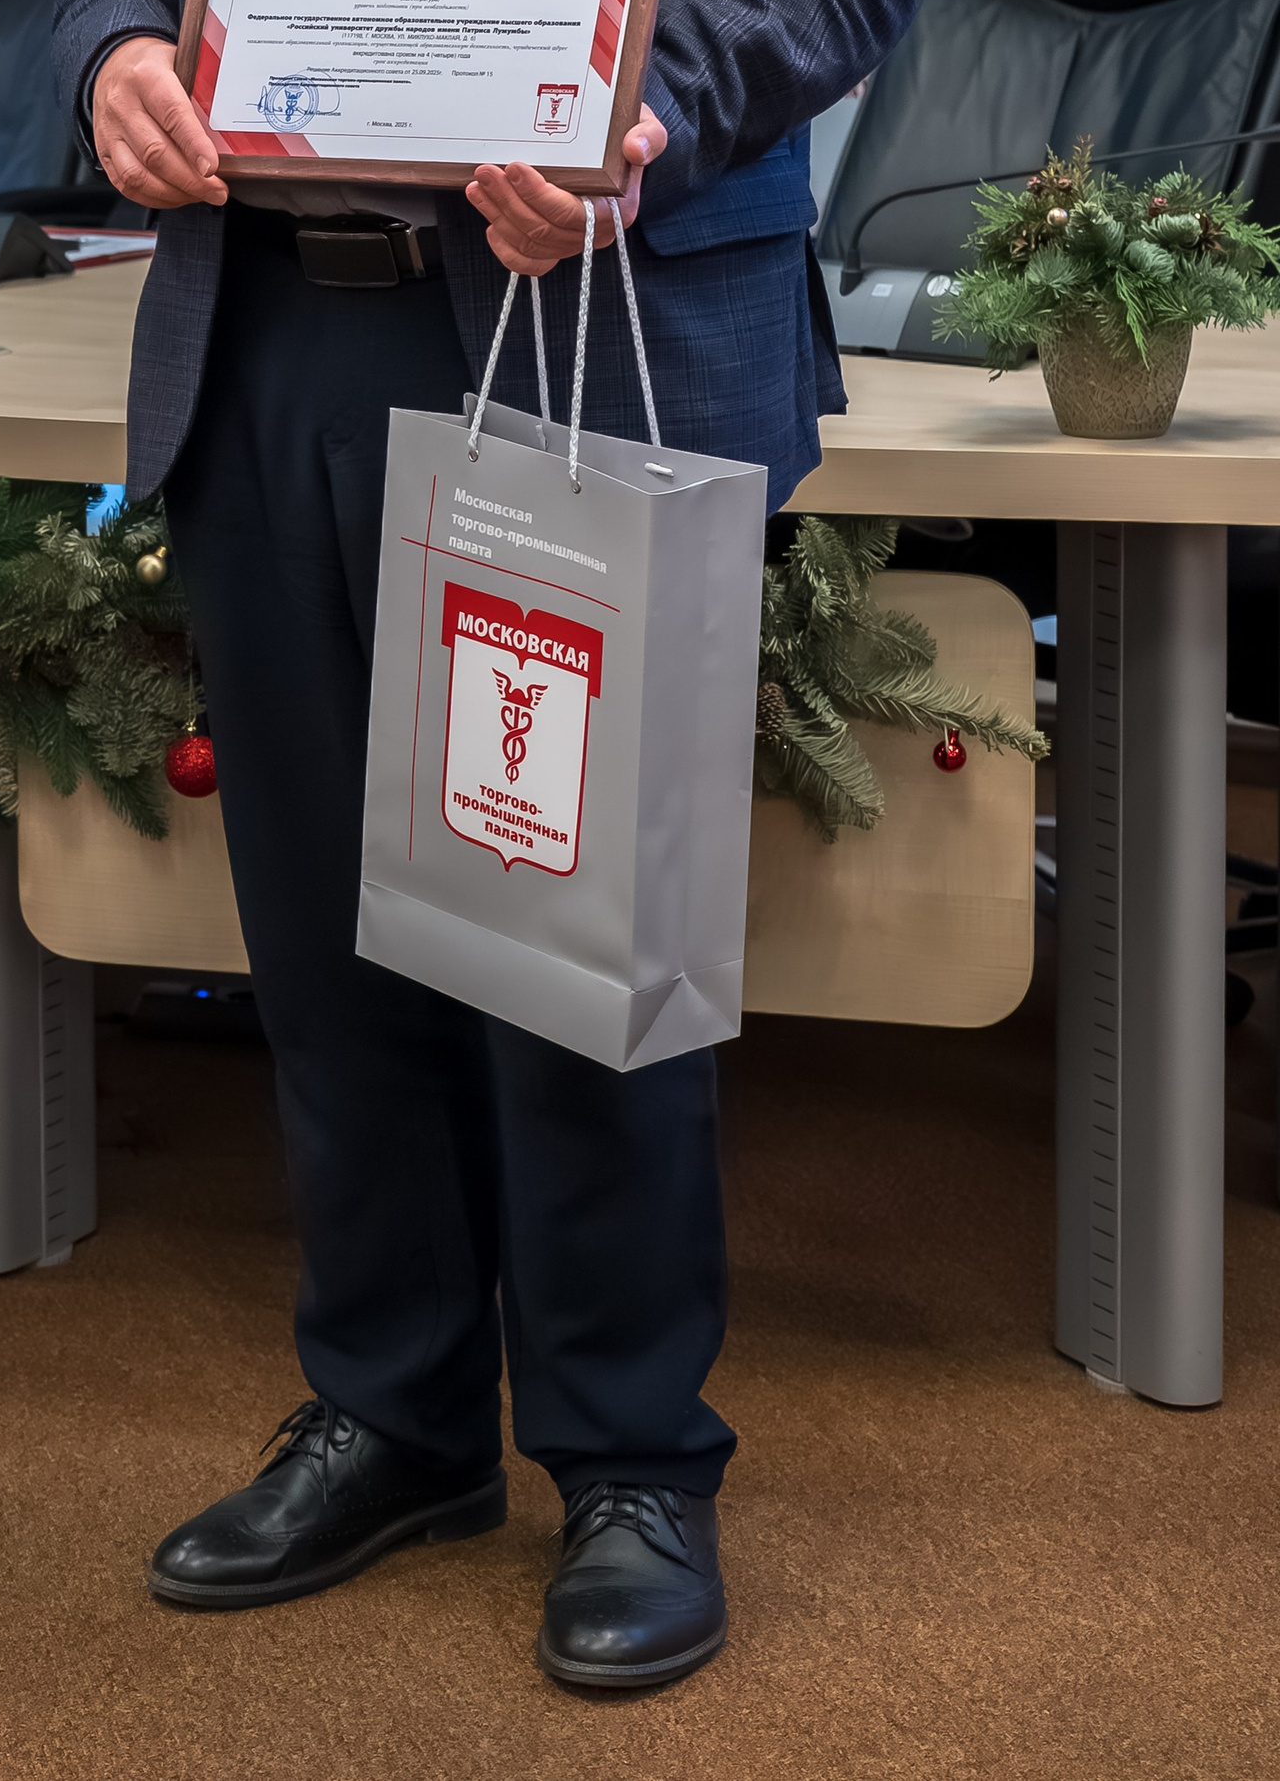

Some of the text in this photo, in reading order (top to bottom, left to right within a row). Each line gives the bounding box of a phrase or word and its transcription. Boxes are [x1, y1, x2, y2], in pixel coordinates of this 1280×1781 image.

[287, 22, 328, 30] «Российский
[331, 24, 373, 32] университет
[375, 24, 404, 32] дружбы
[493, 27, 531, 35] Лумумбы»
[294, 15, 350, 23] государственное
[394, 16, 455, 24] образовательное
[456, 18, 499, 26] учреждение
[533, 19, 581, 27] образования
[431, 51, 457, 59] (четыре)
[453, 487, 533, 525] Московская
[448, 534, 493, 560] палата
[450, 512, 607, 574] торгово-промышленная
[457, 610, 590, 672] МОСКОВСКАЯ
[479, 784, 543, 816] торгово-
[453, 791, 569, 847] промышленная
[484, 822, 534, 850] палата
